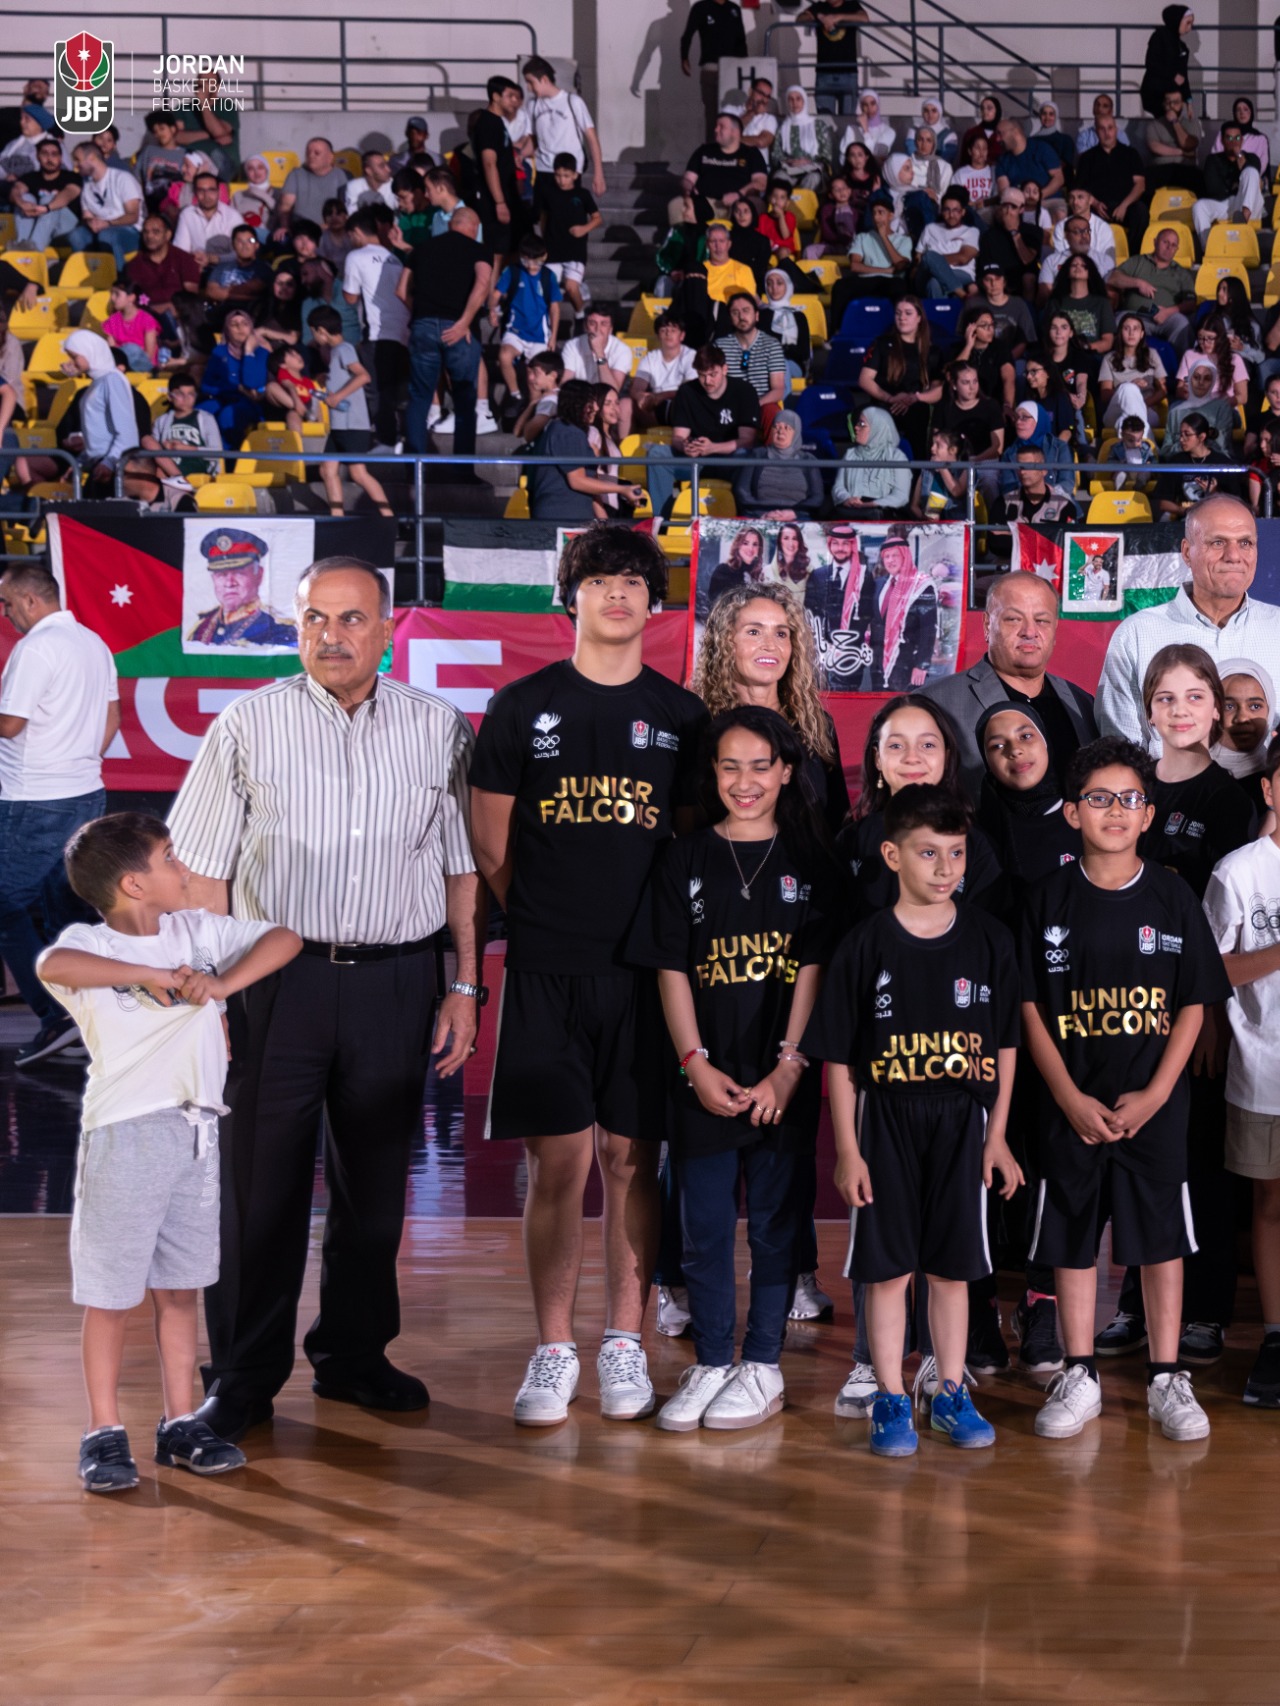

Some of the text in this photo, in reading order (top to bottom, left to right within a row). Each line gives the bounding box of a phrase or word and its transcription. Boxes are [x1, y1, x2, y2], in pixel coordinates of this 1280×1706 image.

[964, 178, 993, 189] JUST
[633, 736, 646, 746] JBF
[553, 775, 653, 803] JUNIOR
[540, 797, 660, 830] FALCONS
[1141, 942, 1154, 951] JBF
[1161, 933, 1183, 945] ORDAN
[1070, 985, 1167, 1012] JUNIOR
[1057, 1010, 1171, 1040] FALCONS
[882, 1030, 983, 1058] JUNIOR
[870, 1053, 997, 1084] FALCONS
